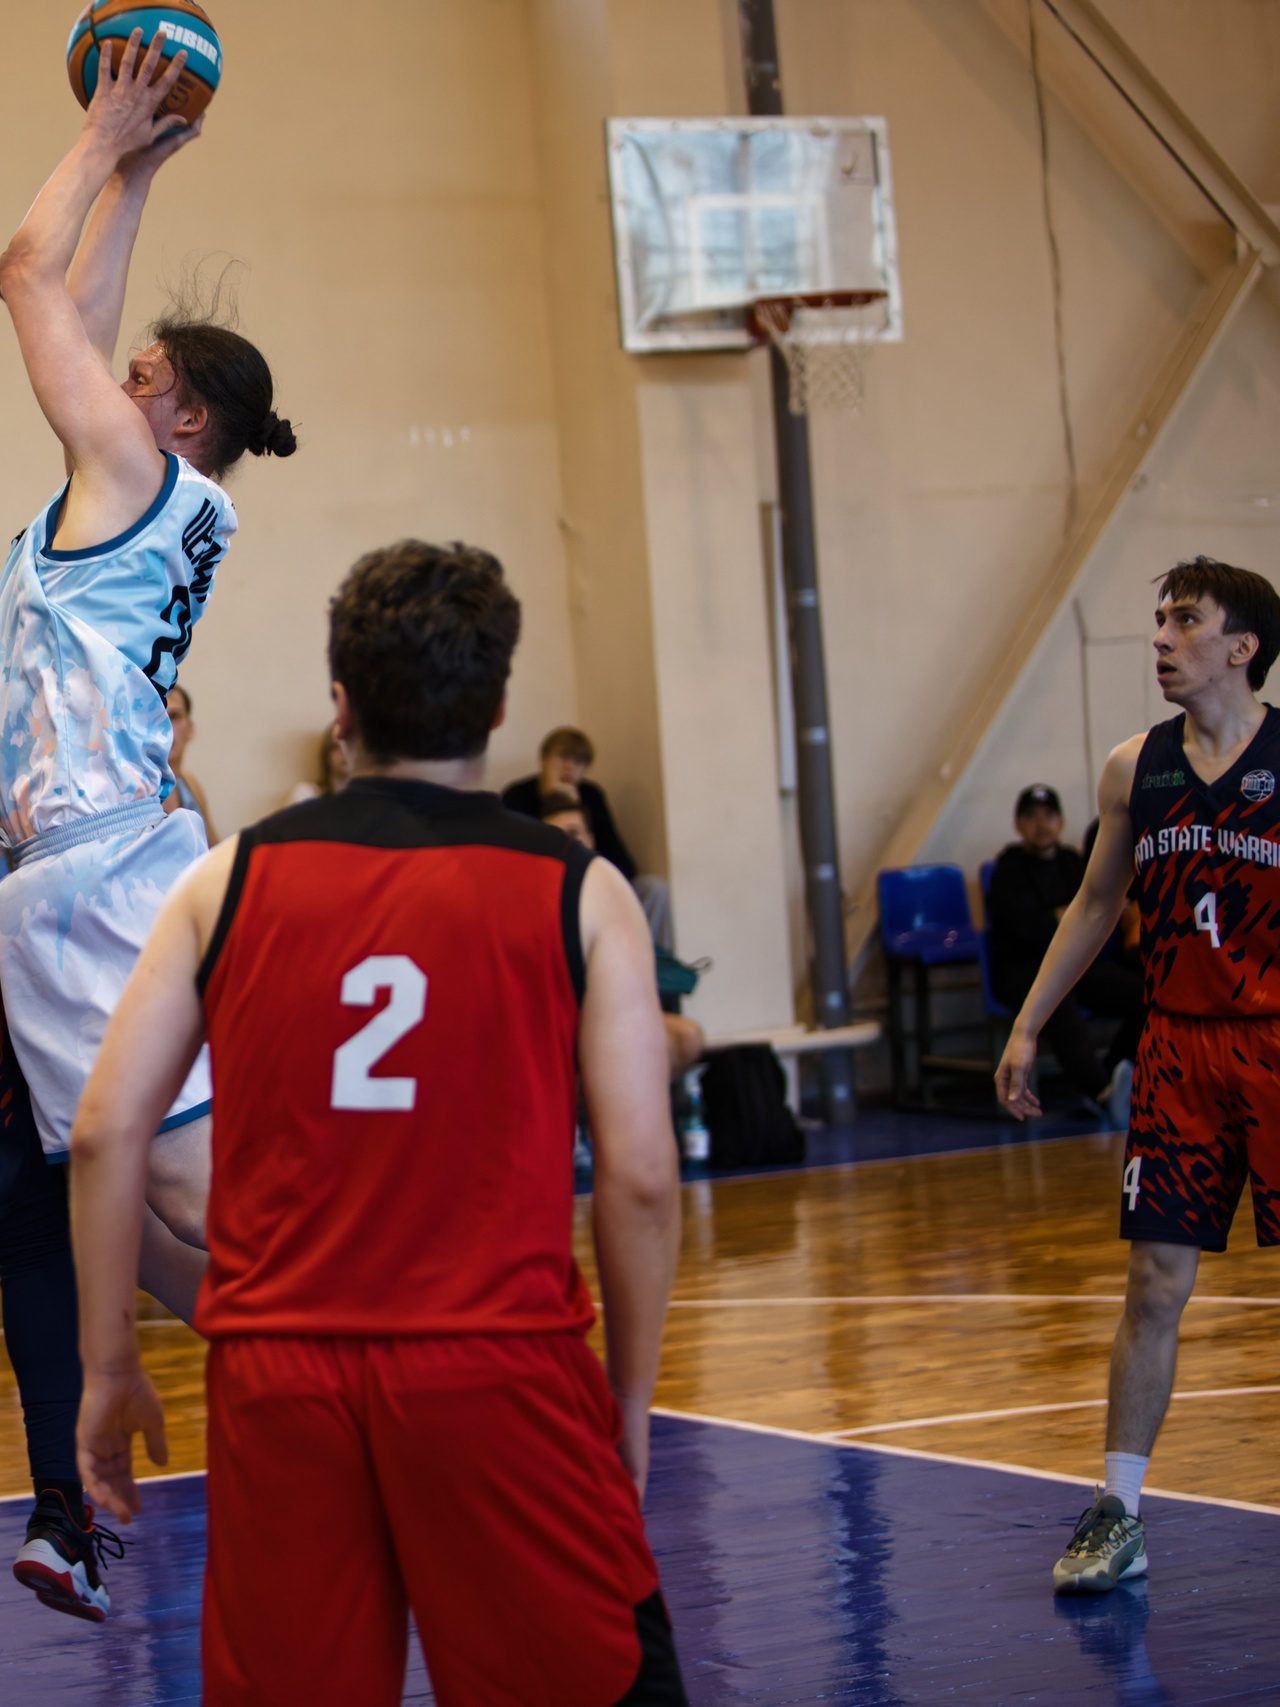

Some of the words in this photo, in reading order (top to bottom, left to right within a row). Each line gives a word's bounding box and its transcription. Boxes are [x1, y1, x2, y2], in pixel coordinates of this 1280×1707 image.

[158, 20, 218, 65] SIBUR
[1157, 824, 1213, 856] STATE
[1218, 828, 1280, 869] WARRI
[1194, 891, 1221, 949] 4
[330, 954, 428, 1112] 2
[1122, 1155, 1142, 1212] 4
